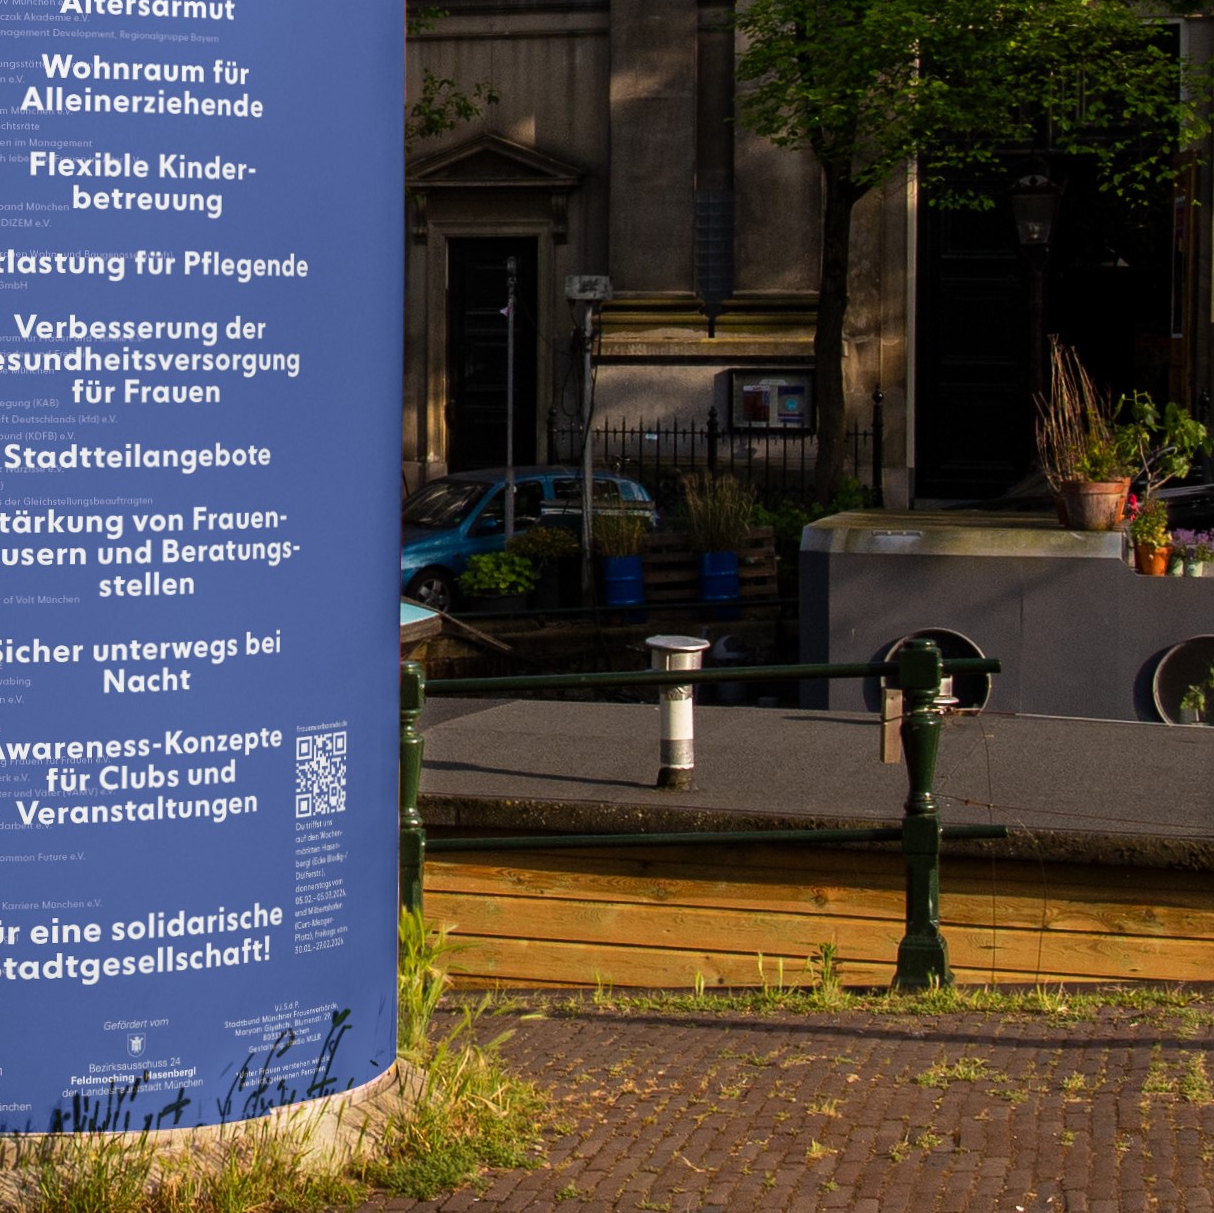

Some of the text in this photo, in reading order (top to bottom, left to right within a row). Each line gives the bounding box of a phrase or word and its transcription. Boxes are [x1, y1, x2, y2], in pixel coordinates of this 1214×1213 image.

[9, 75, 25, 83] e.V.
[42, 54, 249, 84] Wohnraum für
[21, 87, 263, 117] Alleinerziehende
[31, 152, 255, 179] Flexible Kinder-
[74, 185, 222, 218] betreuung
[135, 251, 175, 274] für
[185, 251, 308, 282] Pflegende
[15, 315, 265, 348] Verbesserung der
[72, 379, 219, 403] für Frauen
[5, 443, 270, 474] Stadtteilangebote
[133, 515, 183, 531] von
[194, 507, 286, 530] Frauen-
[98, 537, 151, 564] und
[163, 539, 299, 566] Beratungs-
[100, 572, 194, 597] stellen
[94, 639, 237, 664] unterwegs
[247, 630, 280, 654] bei
[104, 668, 190, 693] Nacht
[47, 759, 235, 791] für Clubs und
[17, 796, 257, 825] Veranstaltungen
[31, 918, 101, 944] eine
[112, 903, 282, 944] solidarische
[104, 1019, 168, 1030] Gefördert vom
[71, 1074, 134, 1085] Feldmoching
[89, 1057, 180, 1074] Bezirksausschuss 24
